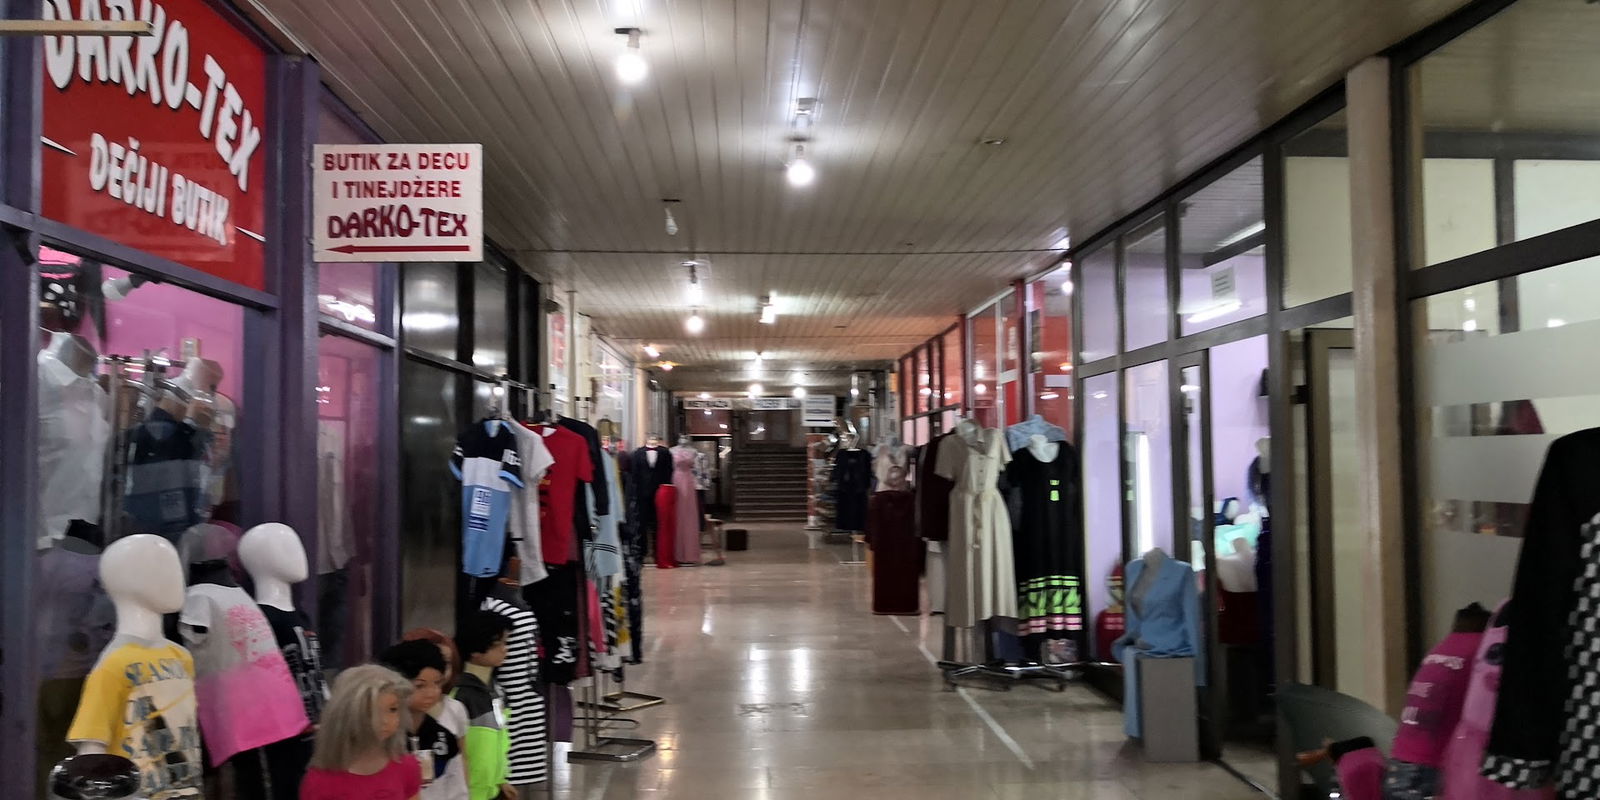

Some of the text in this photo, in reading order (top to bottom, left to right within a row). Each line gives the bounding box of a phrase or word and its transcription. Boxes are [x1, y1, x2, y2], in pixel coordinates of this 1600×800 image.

[43, 0, 261, 192] DARKO-TEX
[323, 152, 470, 171] BUTIK ZA DECU
[89, 133, 230, 246] DEČIJI BUTIK
[332, 176, 462, 199] I TINEJDŽERE
[327, 204, 468, 239] DARKO-TEX
